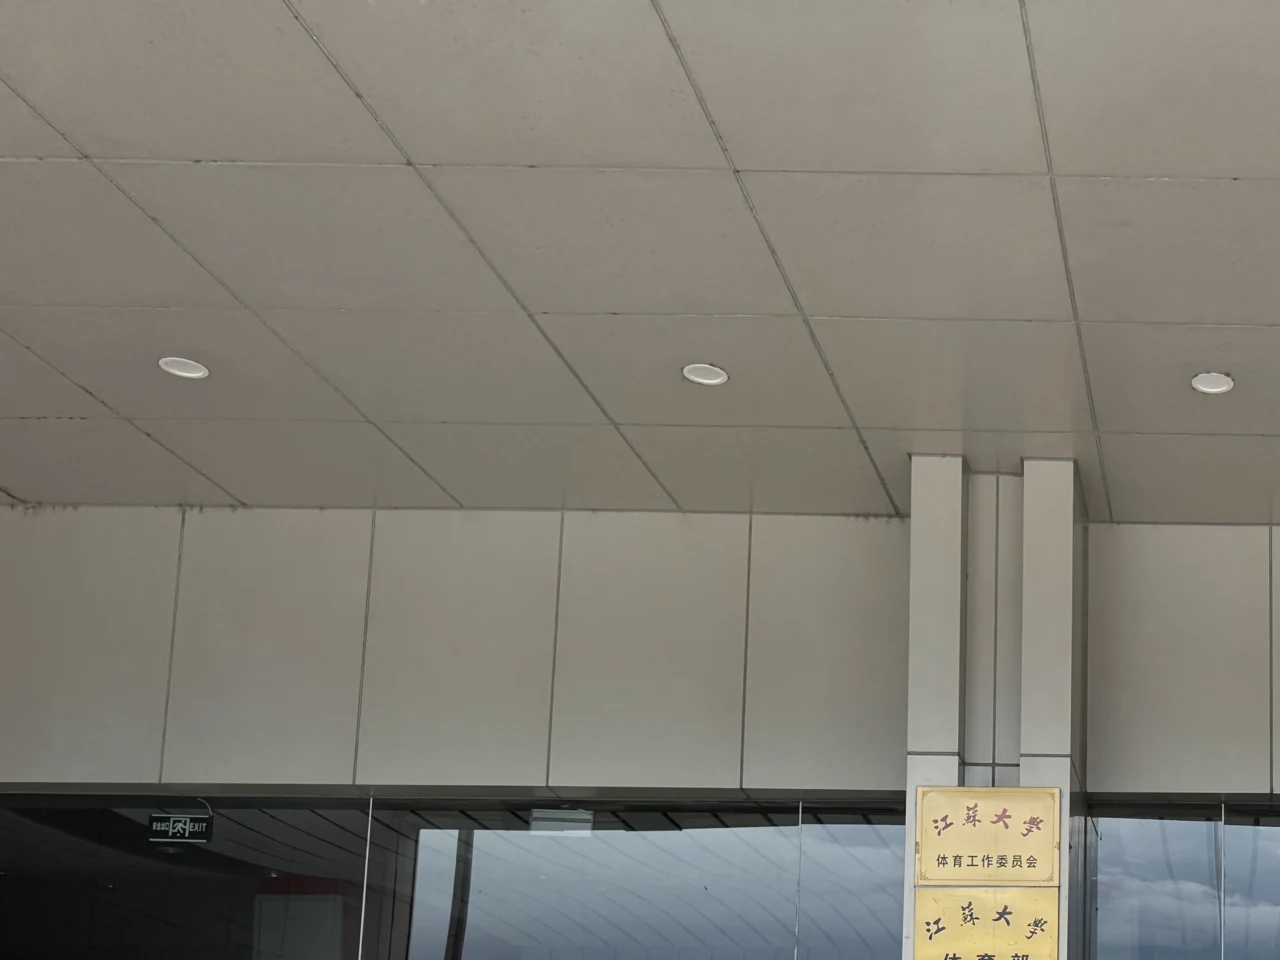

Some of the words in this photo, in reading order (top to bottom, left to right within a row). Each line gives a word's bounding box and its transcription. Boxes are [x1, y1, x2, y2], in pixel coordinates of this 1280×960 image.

[190, 822, 207, 831] EXIT
[936, 854, 1038, 868] 体育工作委员会
